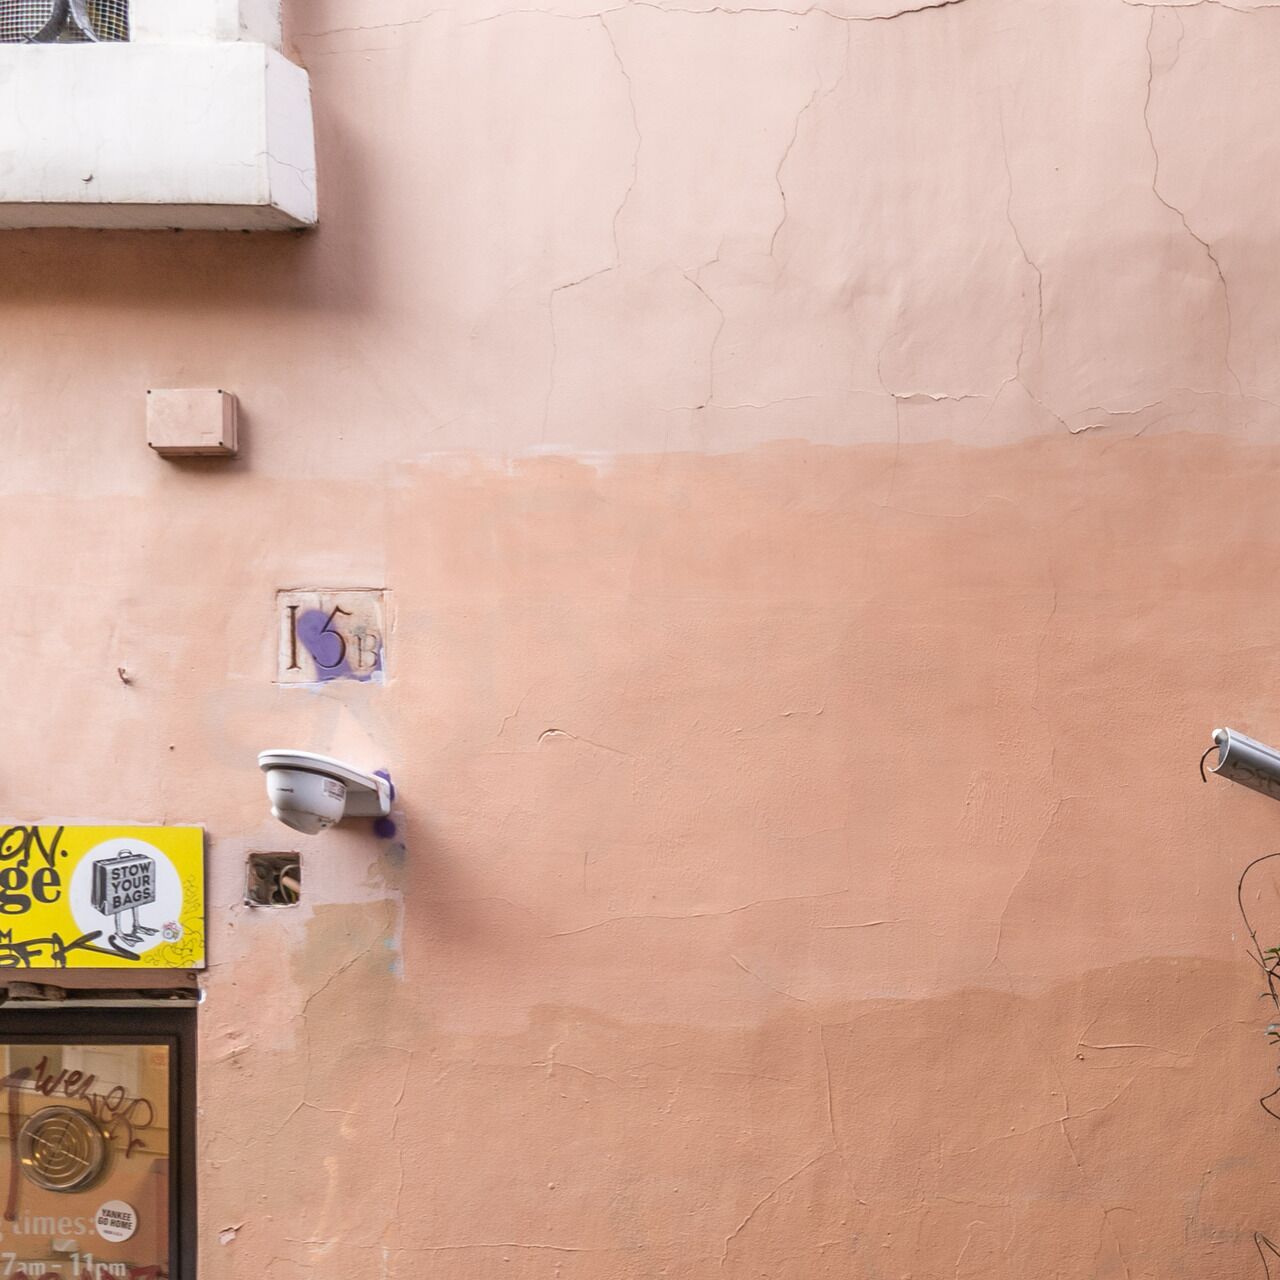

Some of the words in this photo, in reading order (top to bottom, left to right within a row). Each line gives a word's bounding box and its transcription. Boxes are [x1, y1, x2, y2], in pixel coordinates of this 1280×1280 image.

[111, 861, 152, 880] STOW
[111, 874, 151, 894] YOUR
[112, 887, 151, 909] BAGS
[12, 1212, 96, 1236] times:
[97, 1216, 109, 1226] GO
[110, 1218, 133, 1231] HOME
[101, 1208, 133, 1222] YANKEE
[2, 1252, 47, 1277] 7am
